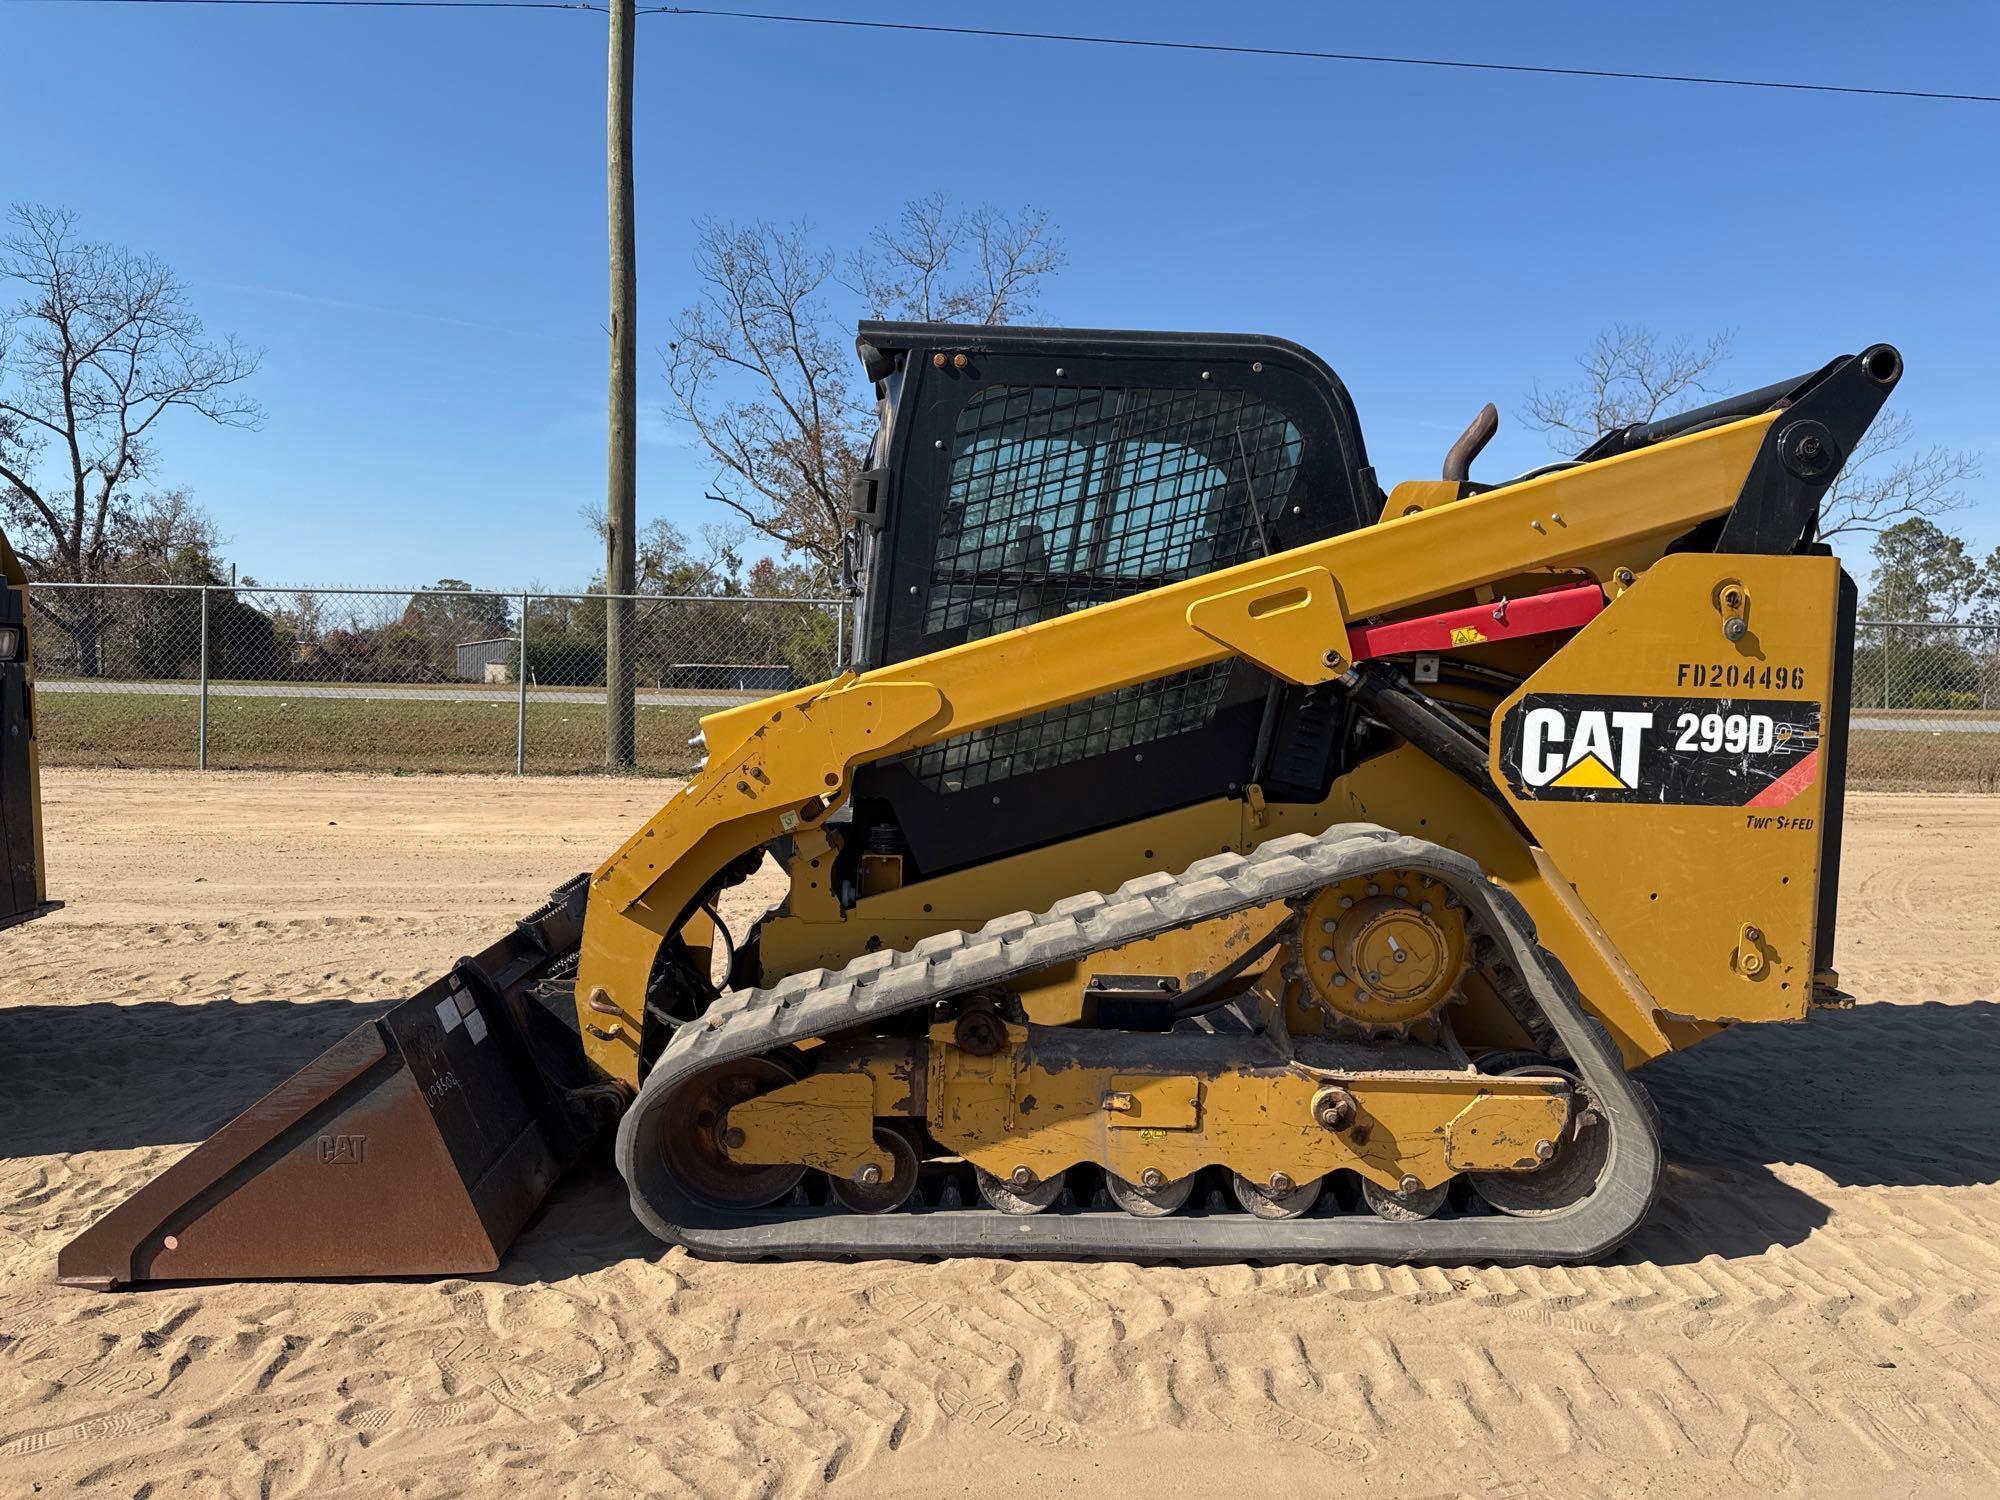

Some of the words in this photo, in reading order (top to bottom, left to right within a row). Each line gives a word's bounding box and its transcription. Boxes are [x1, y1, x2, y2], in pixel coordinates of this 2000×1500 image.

[1677, 664, 1804, 690] FD204496
[1521, 708, 1653, 789] CAT
[317, 1135, 366, 1165] CAT
